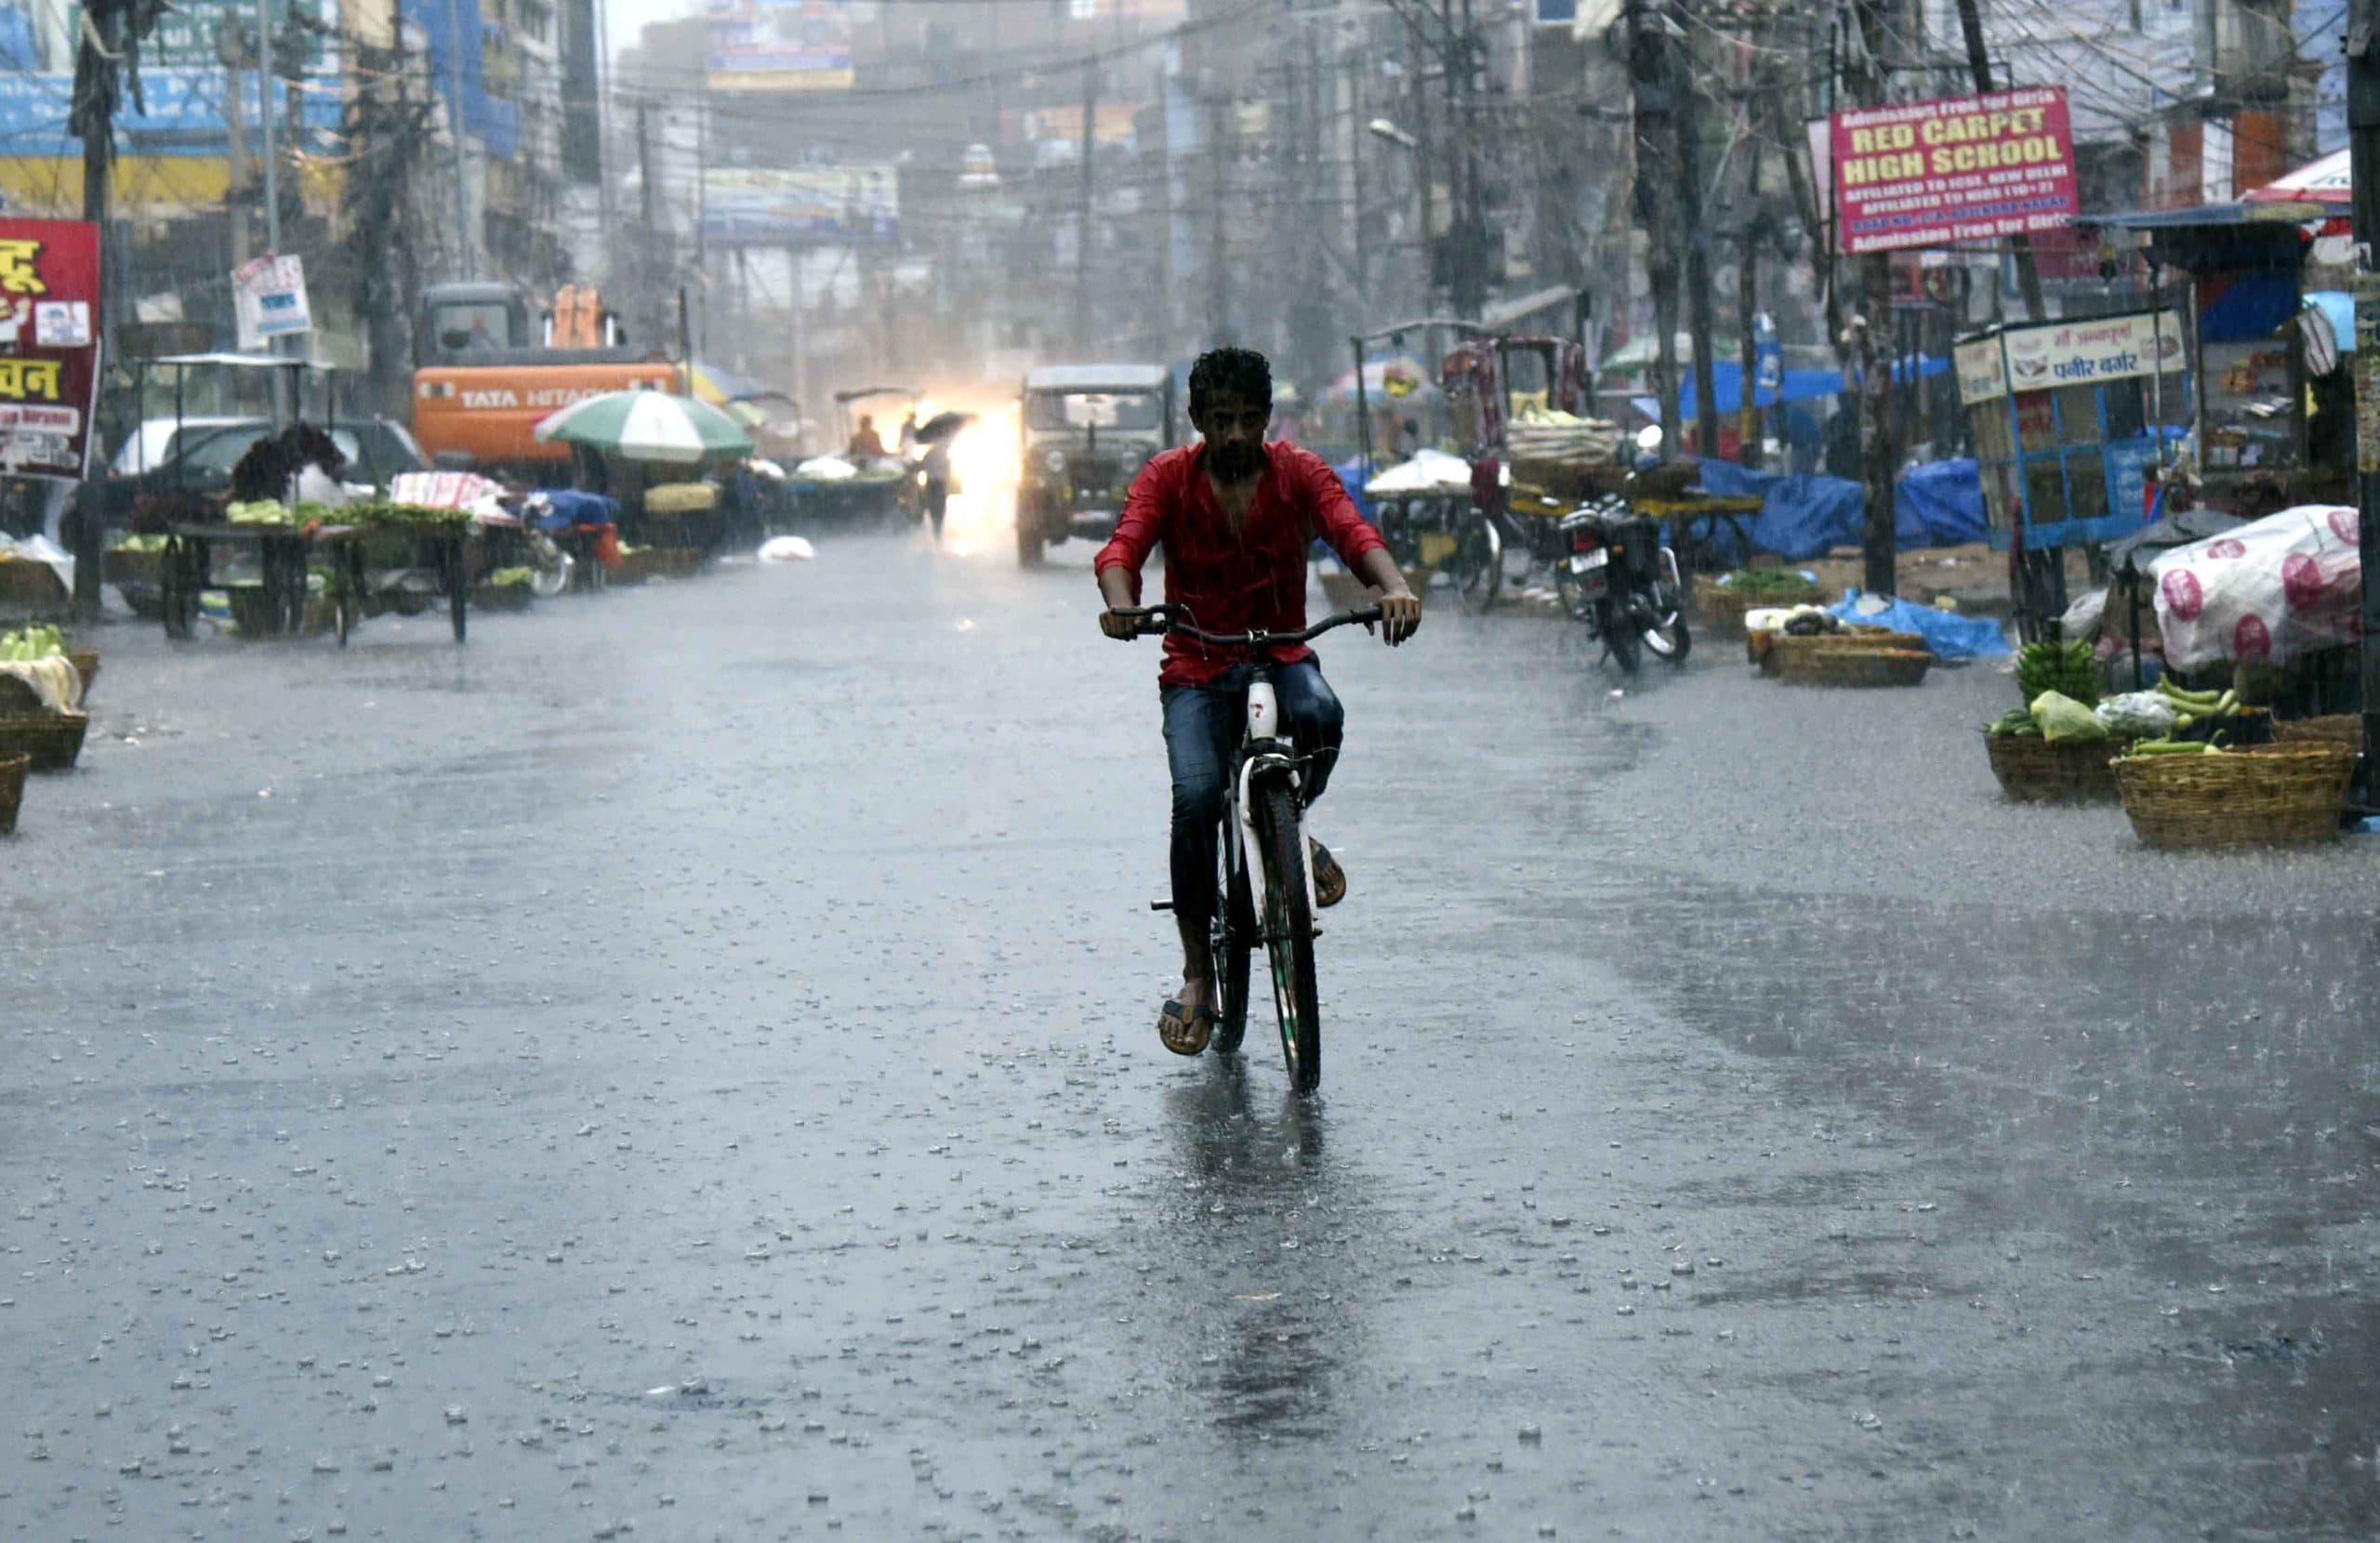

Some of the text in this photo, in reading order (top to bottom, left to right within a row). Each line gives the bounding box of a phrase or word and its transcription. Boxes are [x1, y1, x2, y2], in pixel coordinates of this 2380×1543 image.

[1851, 107, 2045, 154] RED CARPET
[1843, 134, 2063, 185] HIGH SCHOOL
[1926, 178, 1947, 191] TO
[1988, 169, 2023, 184] NEW
[2025, 165, 2069, 181] DELHI
[1944, 191, 1964, 204] TO
[1852, 227, 1951, 252] Admission
[2053, 354, 2096, 379] पनीर
[461, 389, 519, 408] TATA
